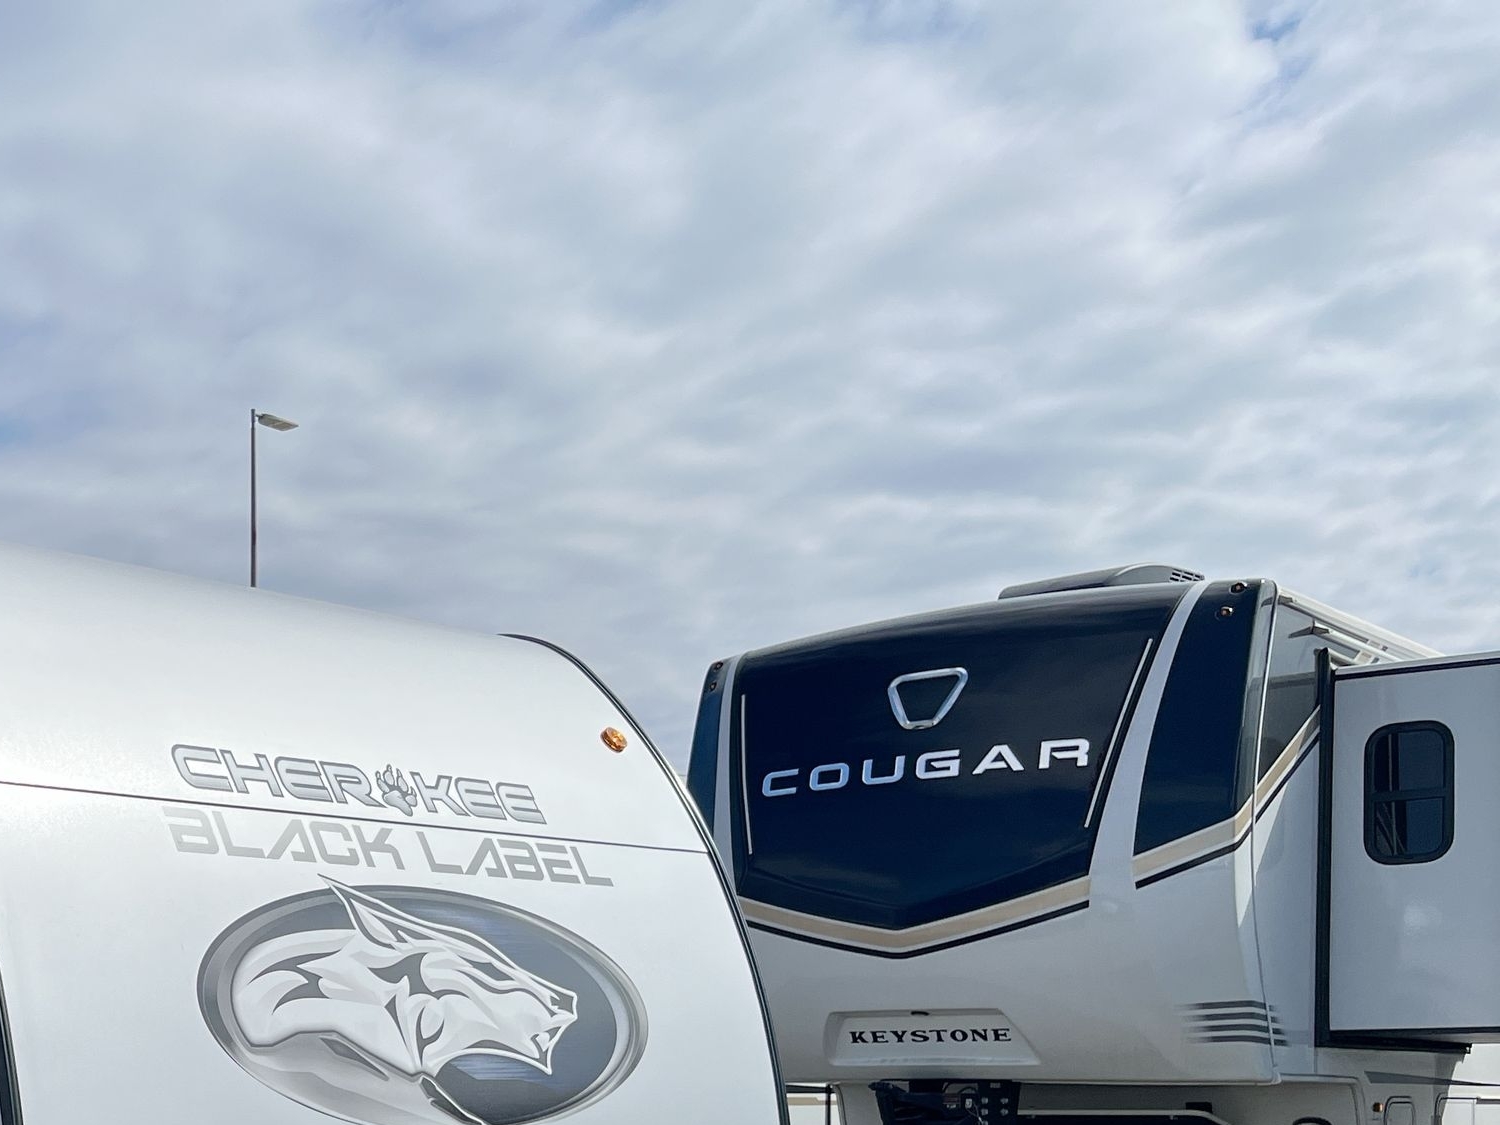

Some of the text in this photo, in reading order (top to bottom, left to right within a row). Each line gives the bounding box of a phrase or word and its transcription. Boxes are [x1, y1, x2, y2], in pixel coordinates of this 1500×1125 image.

[761, 738, 1090, 797] COUGAR
[162, 805, 614, 887] BLACK LABEL
[849, 1028, 1012, 1044] KEYSTONE
